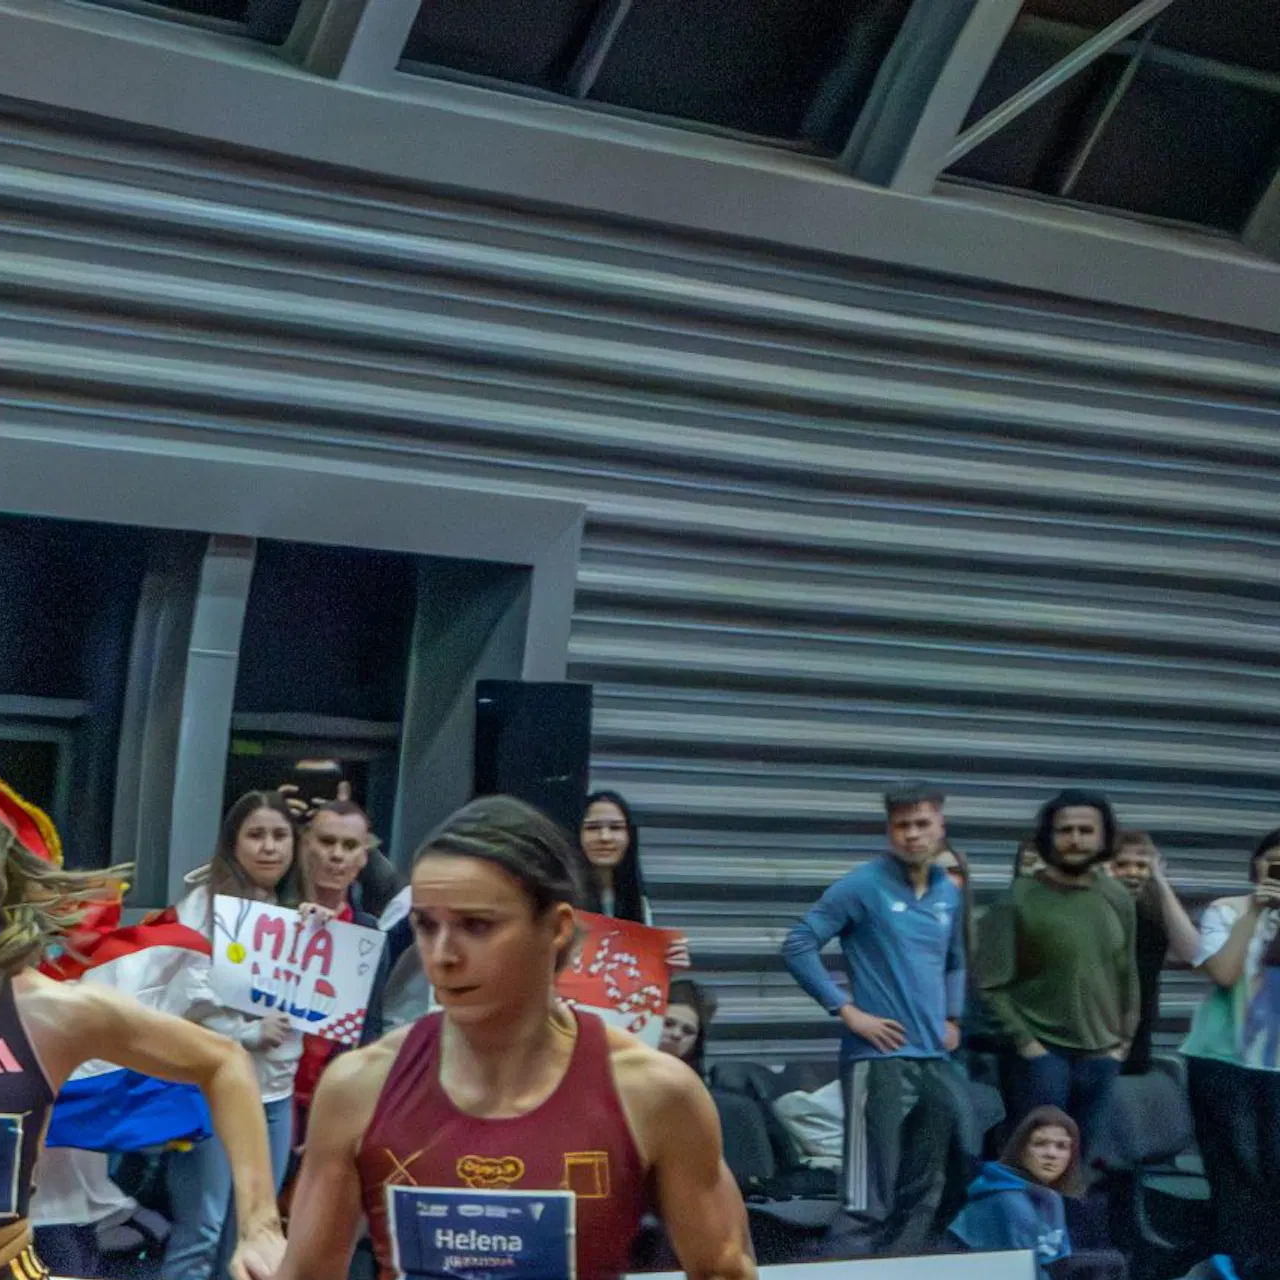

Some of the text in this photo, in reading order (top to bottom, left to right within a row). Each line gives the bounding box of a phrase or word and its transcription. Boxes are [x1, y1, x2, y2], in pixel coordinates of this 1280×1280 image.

[253, 912, 333, 976] MIA
[251, 961, 336, 1022] WILD
[435, 1228, 523, 1252] Helena
